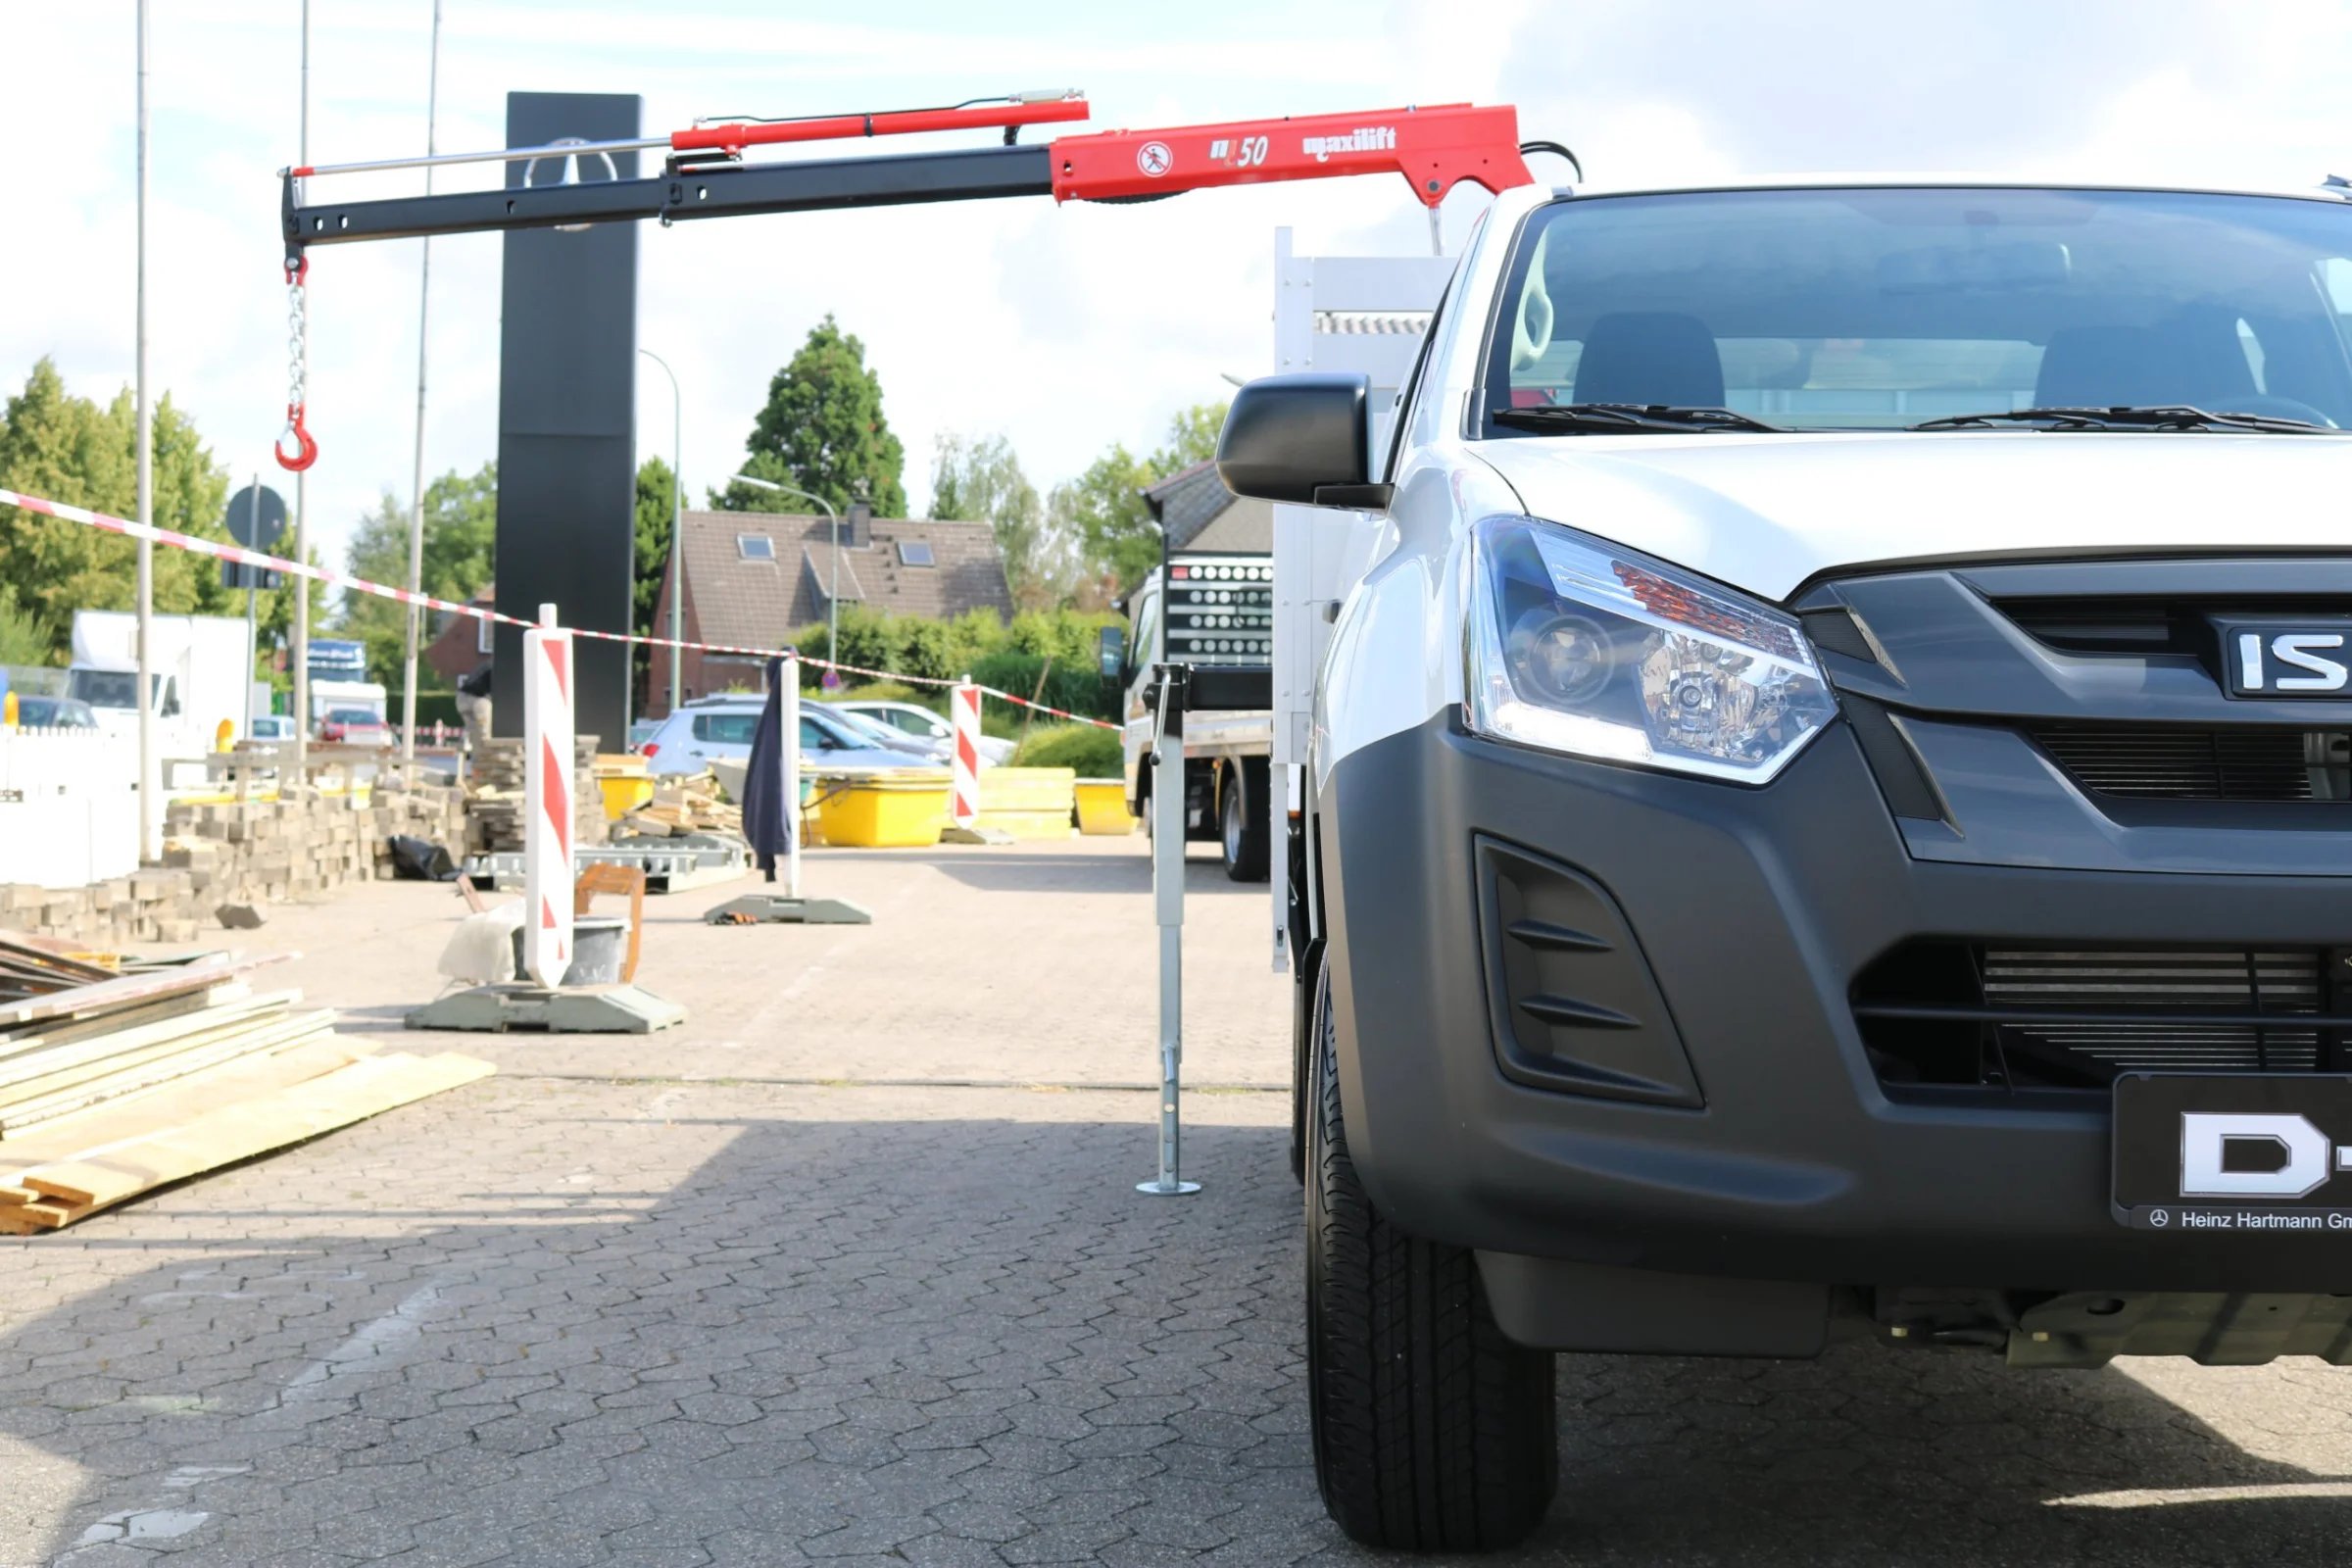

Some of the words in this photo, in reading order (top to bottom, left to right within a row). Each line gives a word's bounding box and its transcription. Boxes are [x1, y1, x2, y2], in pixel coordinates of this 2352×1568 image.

[1302, 125, 1396, 163] maxilift
[2239, 633, 2348, 690] IS
[2181, 1211, 2231, 1228] Heinz
[2237, 1212, 2322, 1229] Hartmann
